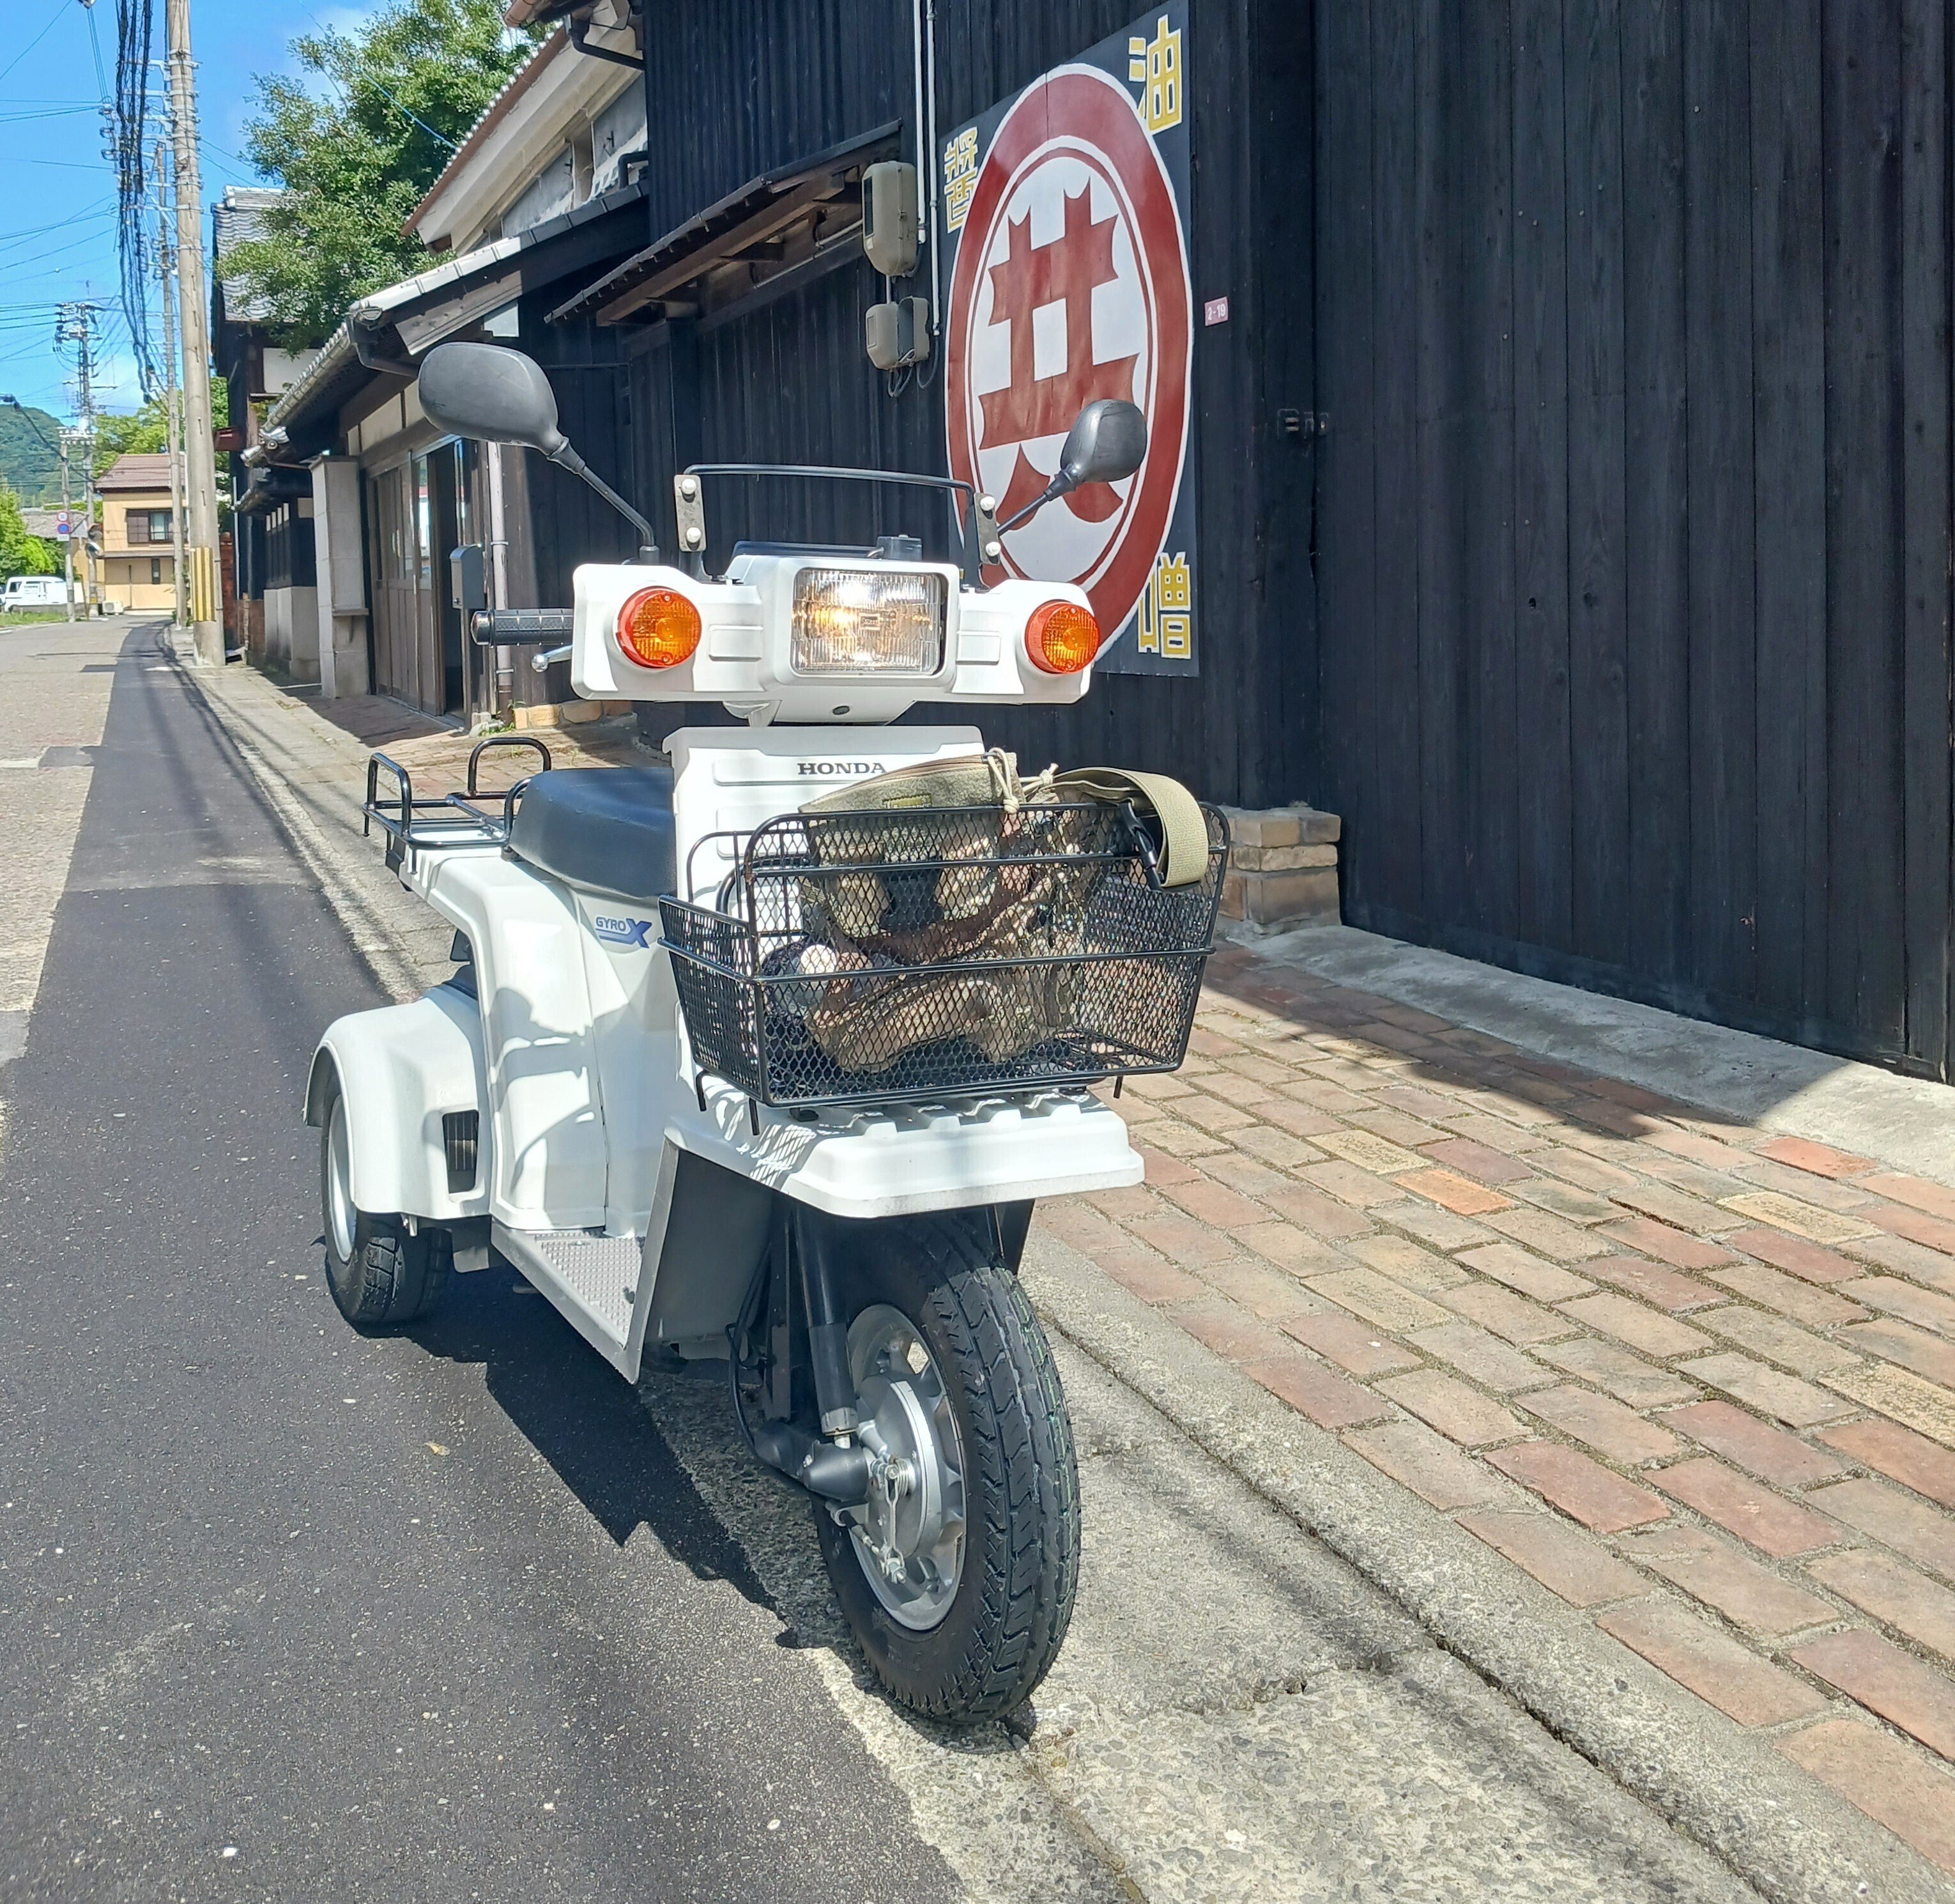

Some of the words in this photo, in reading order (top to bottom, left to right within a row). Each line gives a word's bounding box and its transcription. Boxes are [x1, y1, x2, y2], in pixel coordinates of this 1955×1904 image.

[1128, 14, 1182, 135] 油
[1208, 303, 1226, 321] 2-19
[797, 762, 887, 775] HONDA
[595, 916, 626, 932] GYRO
[625, 917, 652, 949] X
